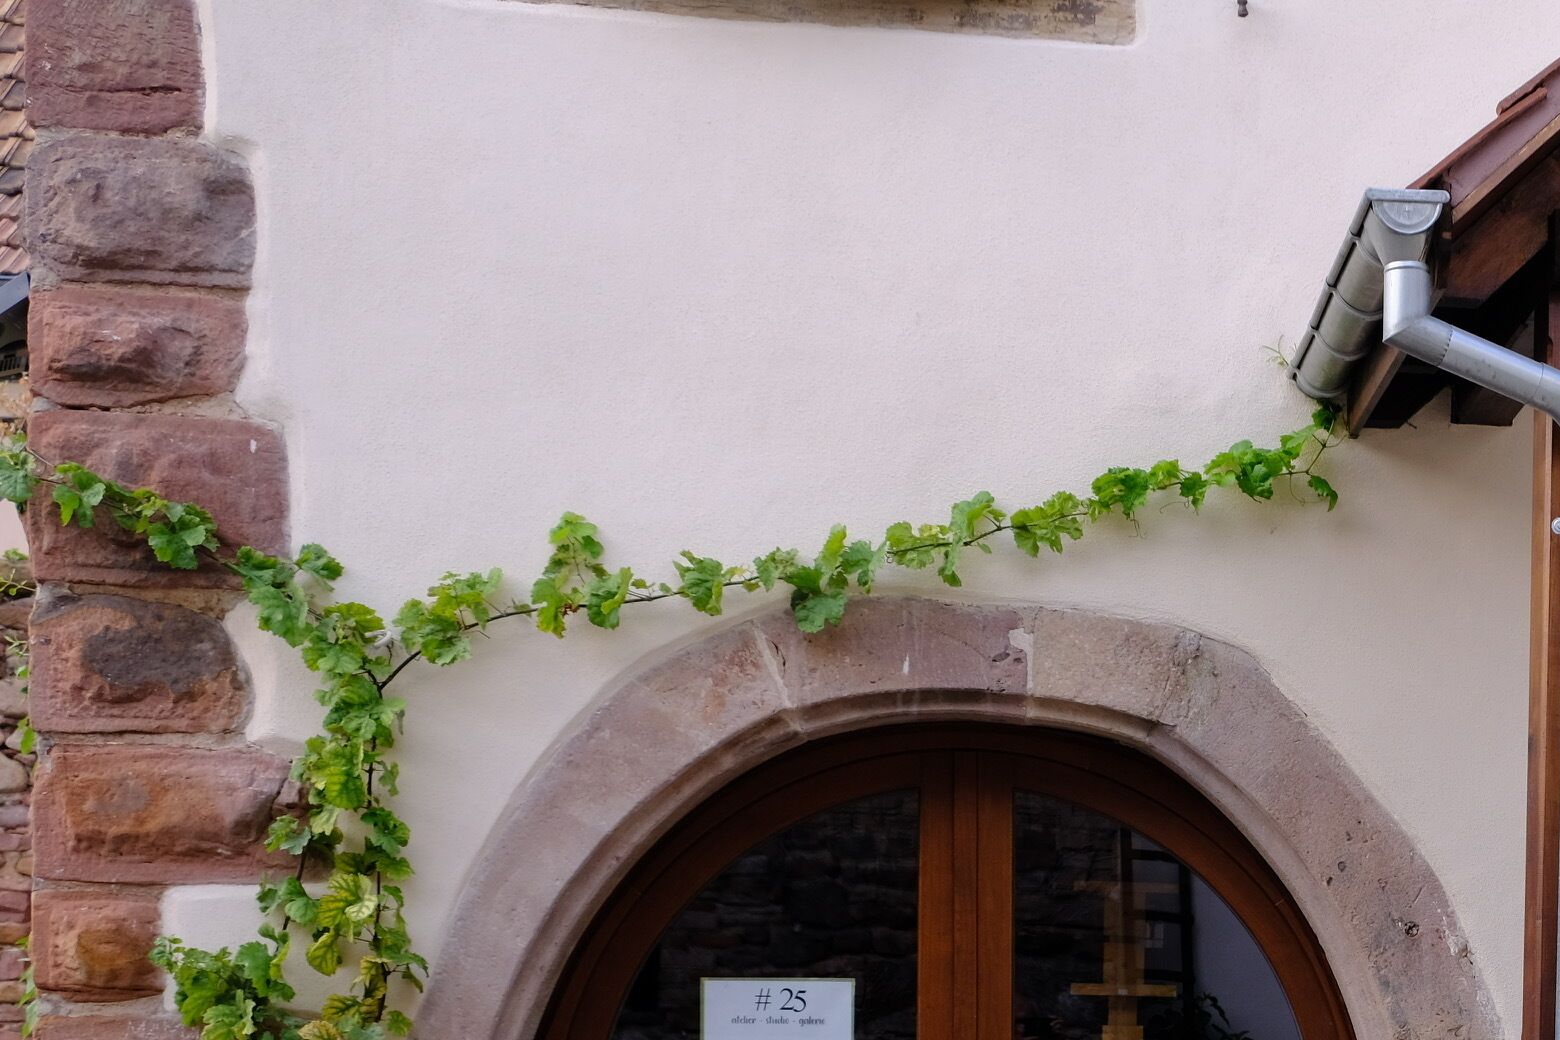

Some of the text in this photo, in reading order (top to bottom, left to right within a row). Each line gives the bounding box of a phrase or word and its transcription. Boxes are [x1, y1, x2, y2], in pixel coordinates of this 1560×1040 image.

[754, 987, 807, 1013] # 25
[765, 1015, 790, 1025] studio
